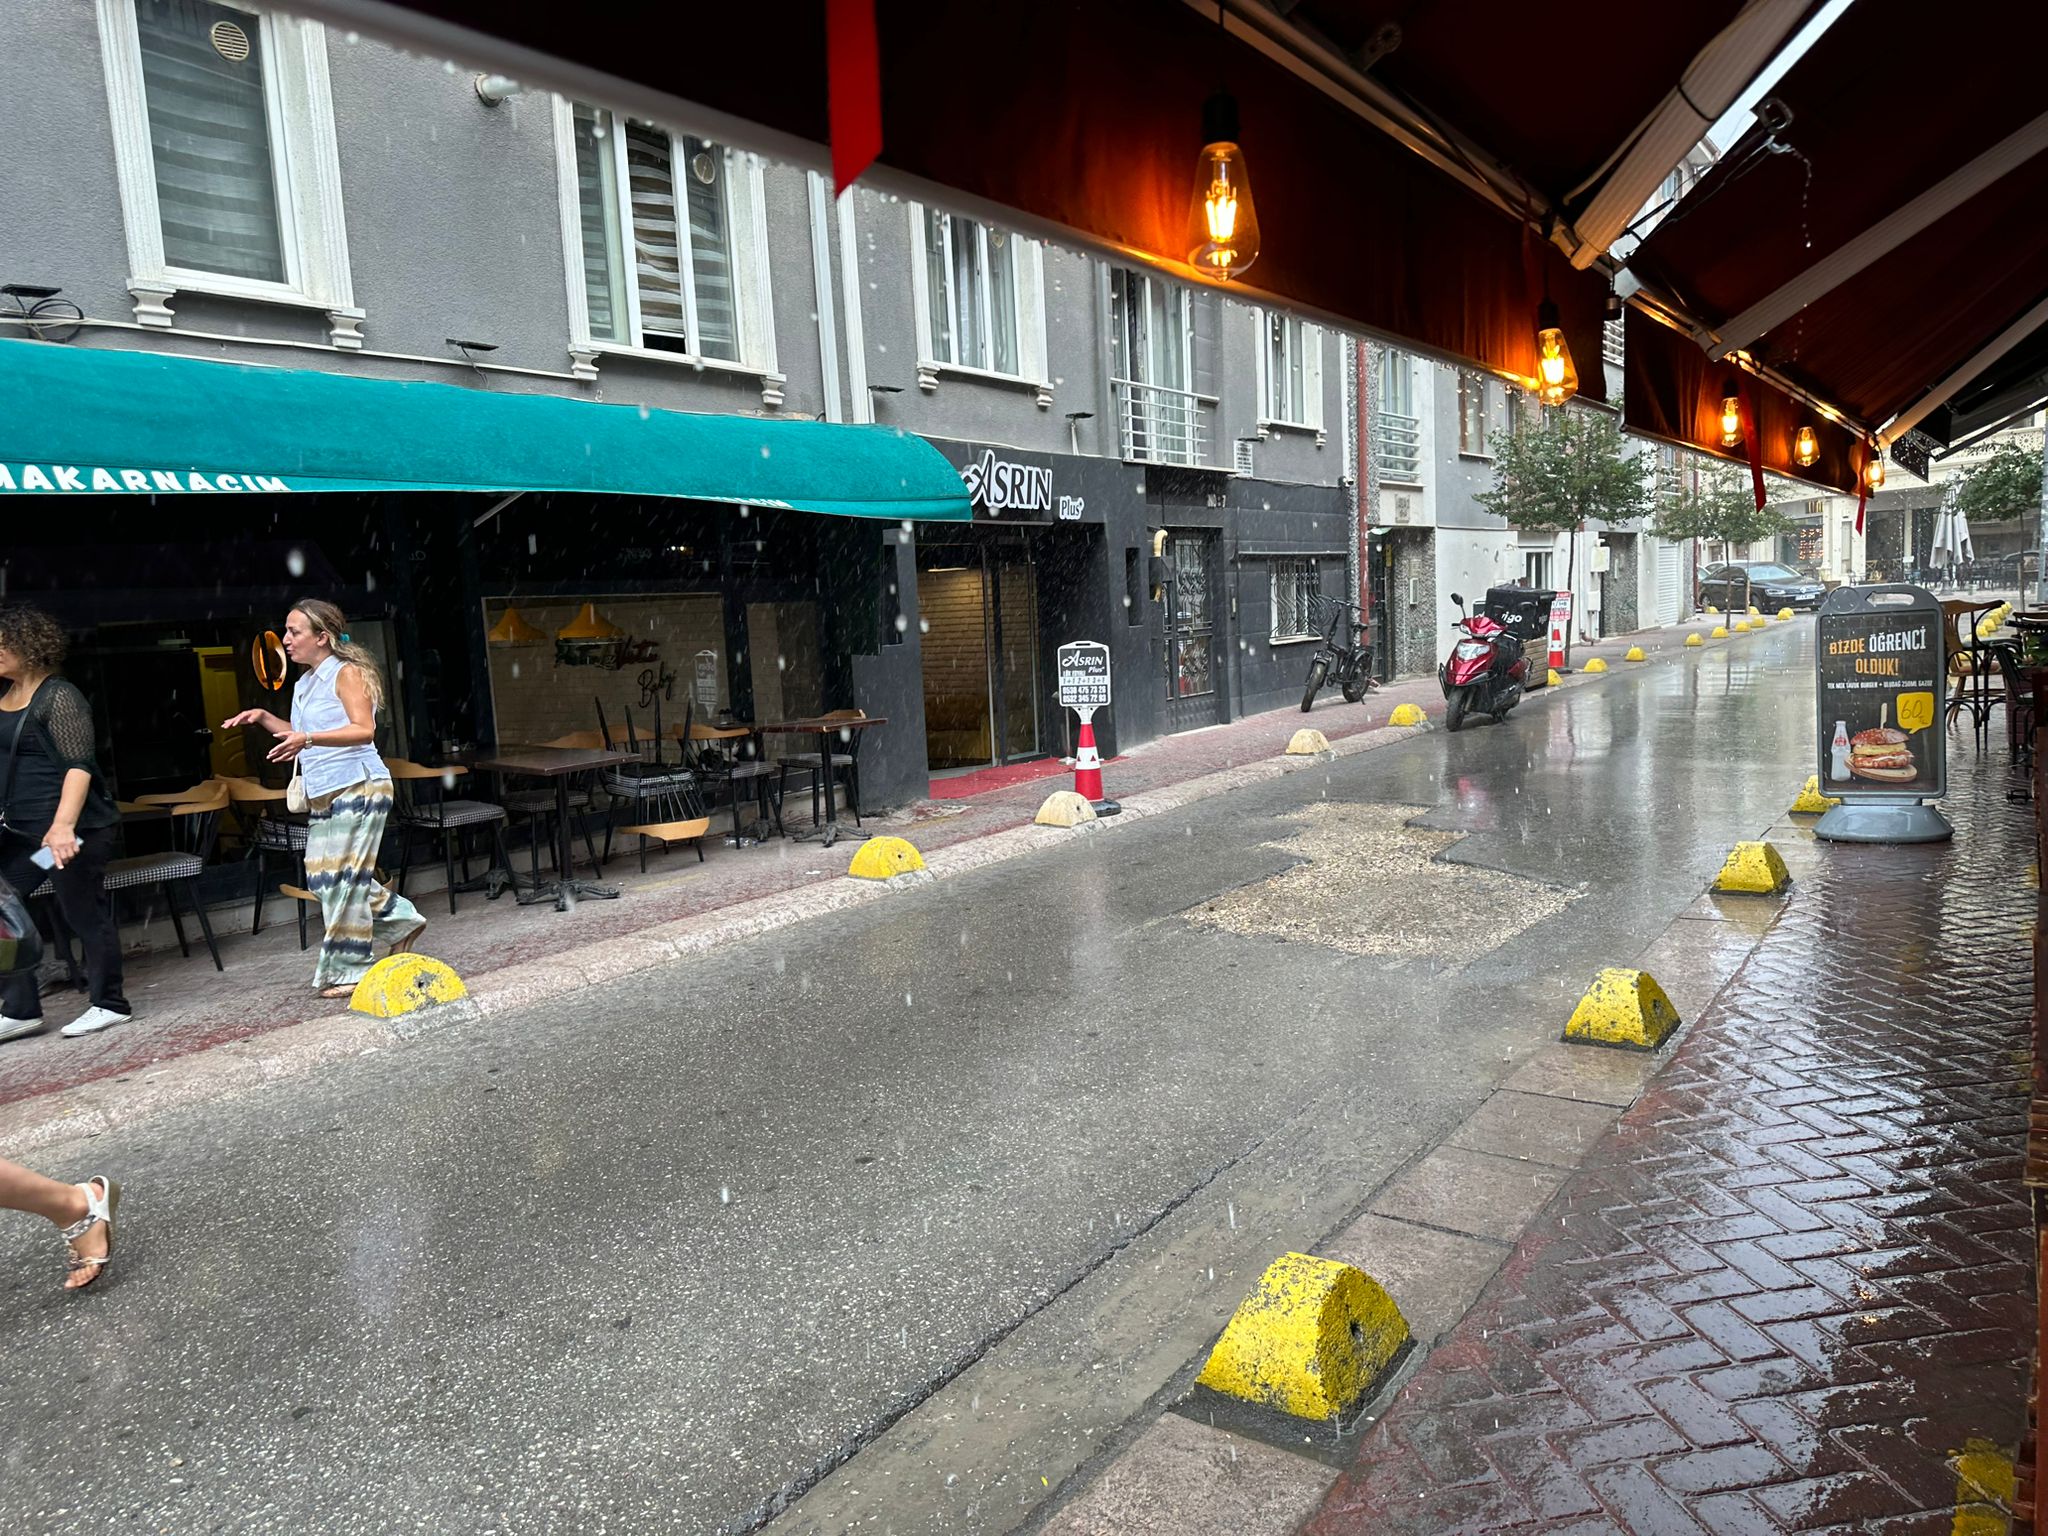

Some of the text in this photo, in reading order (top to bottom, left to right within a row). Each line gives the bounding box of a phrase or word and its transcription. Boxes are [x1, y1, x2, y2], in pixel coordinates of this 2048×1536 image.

[961, 450, 1052, 510] ASRIN
[1829, 626, 1927, 655] BİZDE ÖĞRENCİ
[1062, 650, 1103, 667] ASRIN
[1855, 658, 1899, 676] OLDUK!
[1901, 700, 1922, 719] 60
